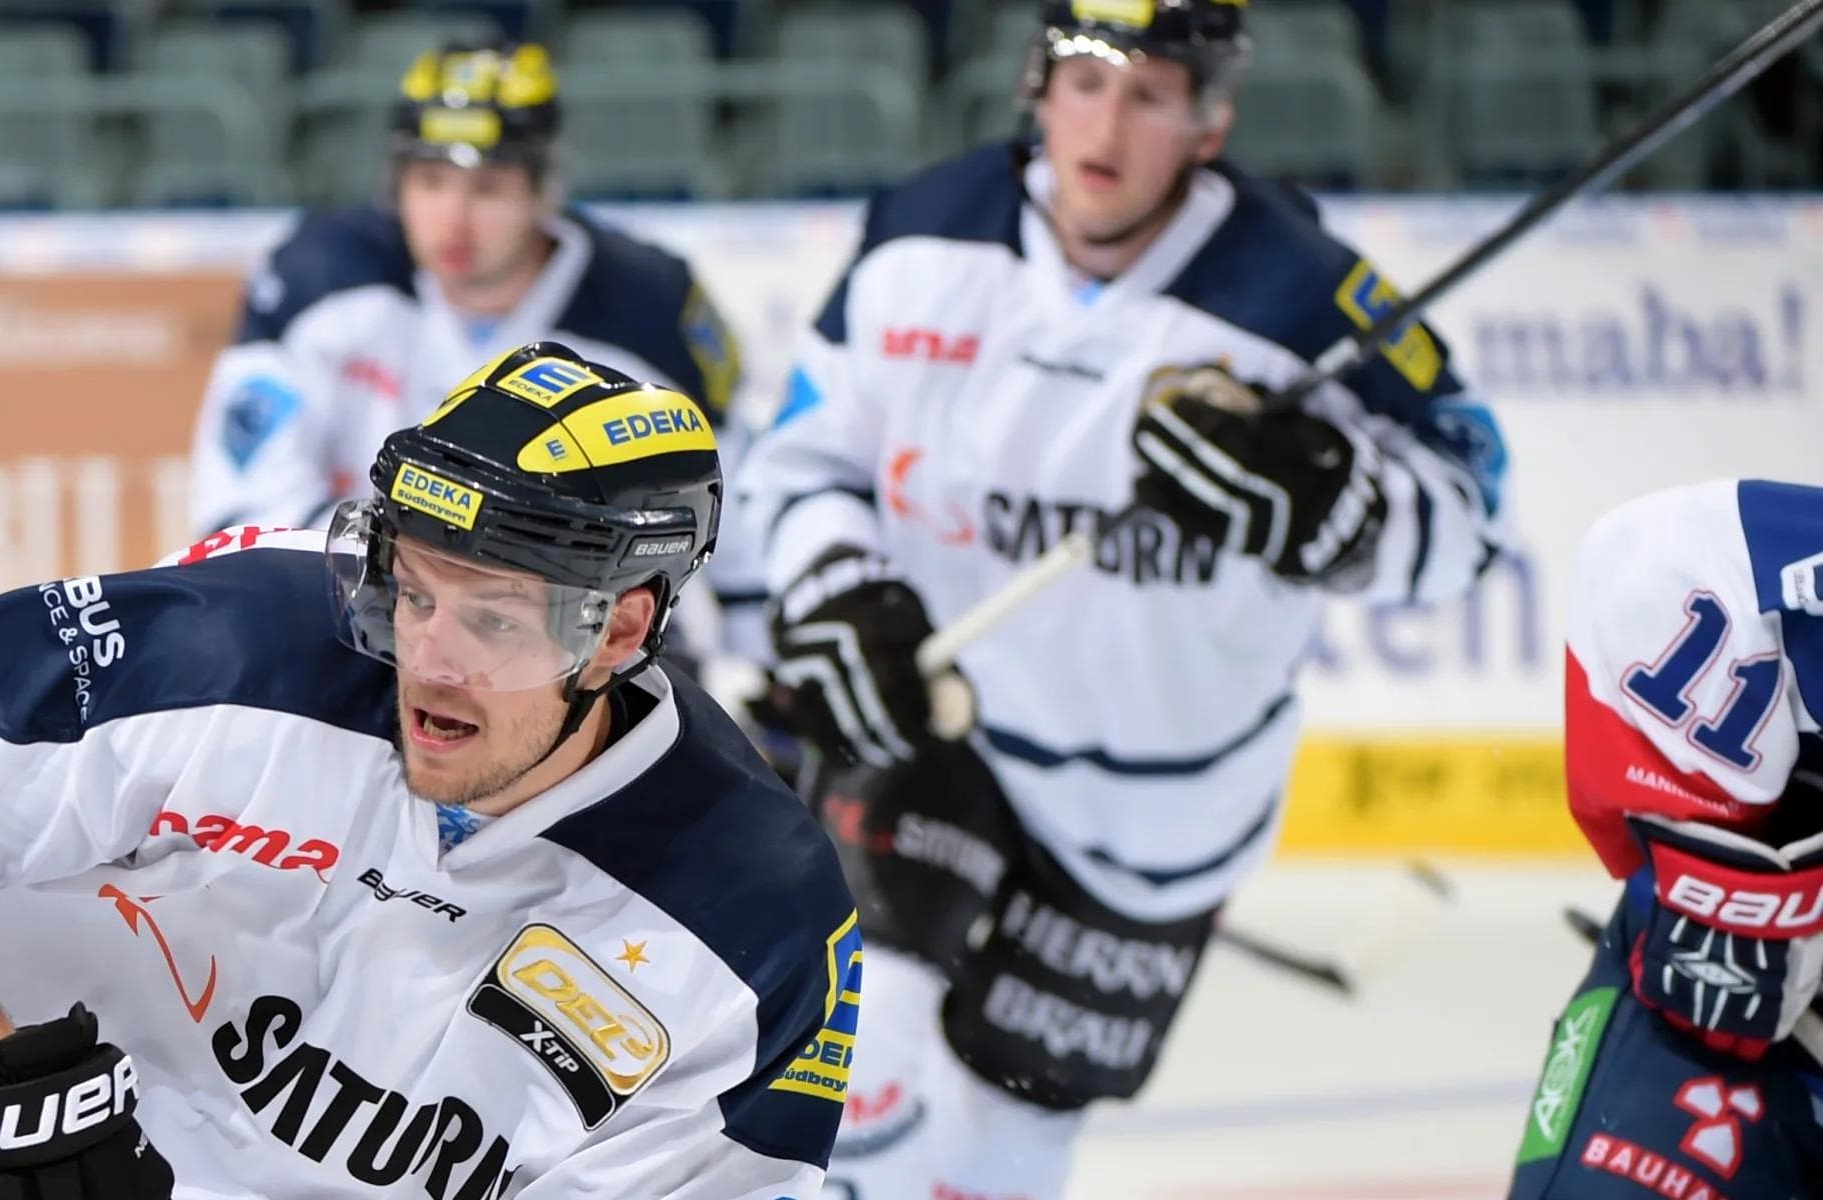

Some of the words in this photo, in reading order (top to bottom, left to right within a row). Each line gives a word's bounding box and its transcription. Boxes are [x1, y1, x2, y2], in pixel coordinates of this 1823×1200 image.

[601, 408, 705, 446] EDEKA
[400, 470, 472, 511] EDEKA
[1620, 589, 1785, 774] 11
[512, 958, 654, 1062] DEL
